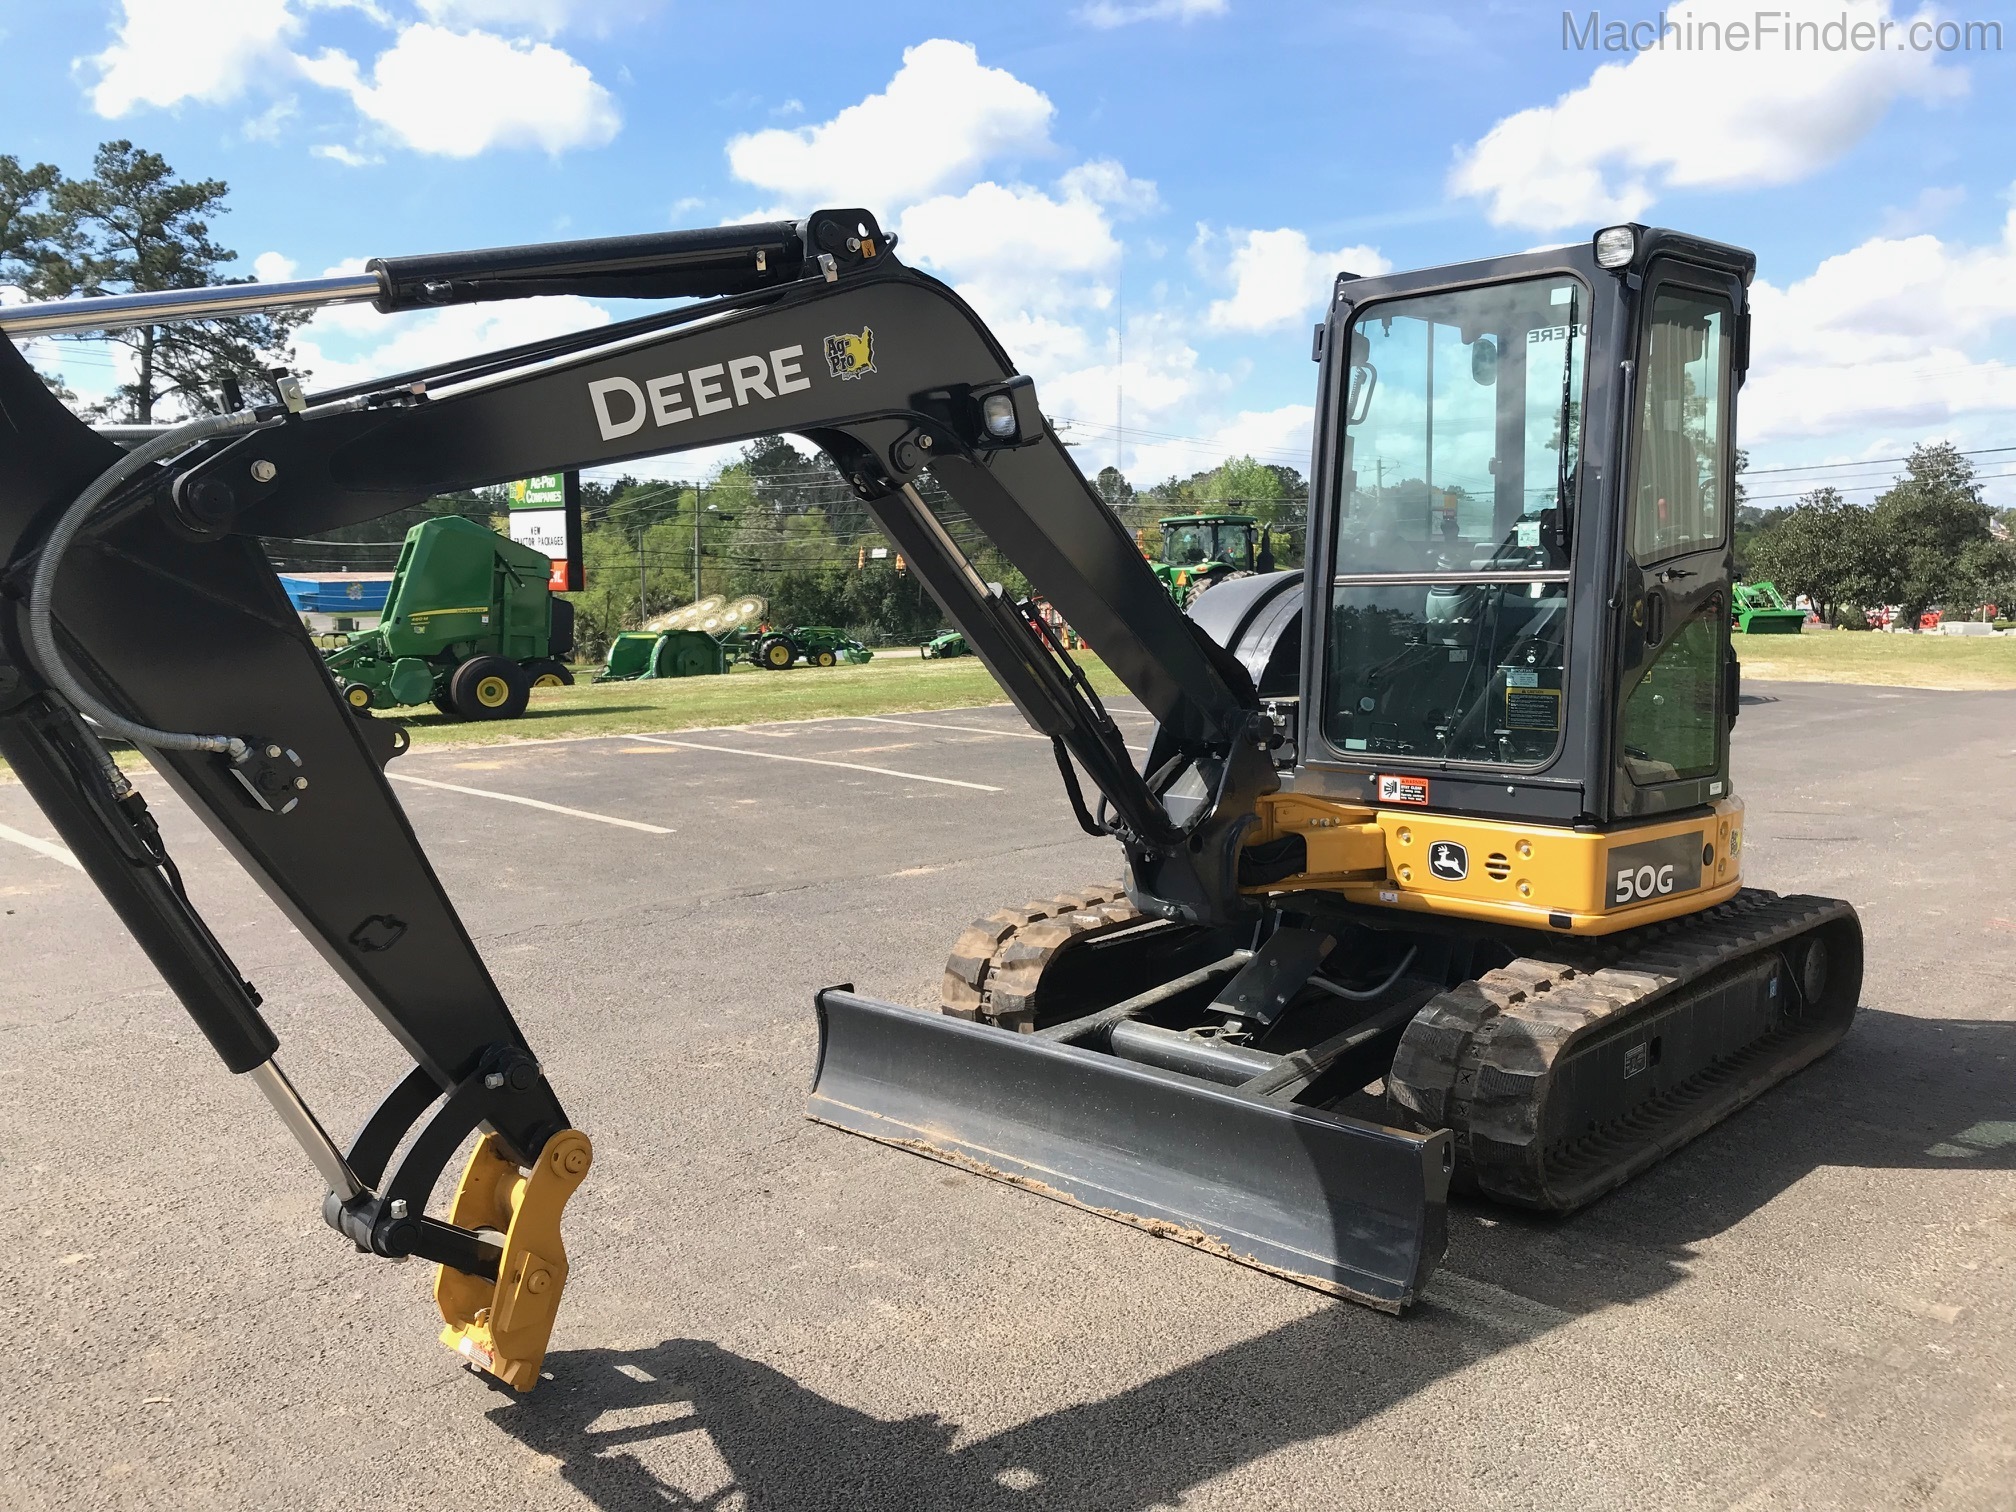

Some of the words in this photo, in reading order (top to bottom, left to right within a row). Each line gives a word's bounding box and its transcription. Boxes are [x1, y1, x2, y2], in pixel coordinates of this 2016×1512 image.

[827, 338, 850, 357] Ag-
[830, 354, 855, 374] Pro
[588, 344, 811, 441] DEERE
[525, 490, 561, 504] COMPANIES
[531, 526, 541, 535] NEW
[538, 536, 564, 546] PACKAGES
[1616, 864, 1674, 903] 50G
